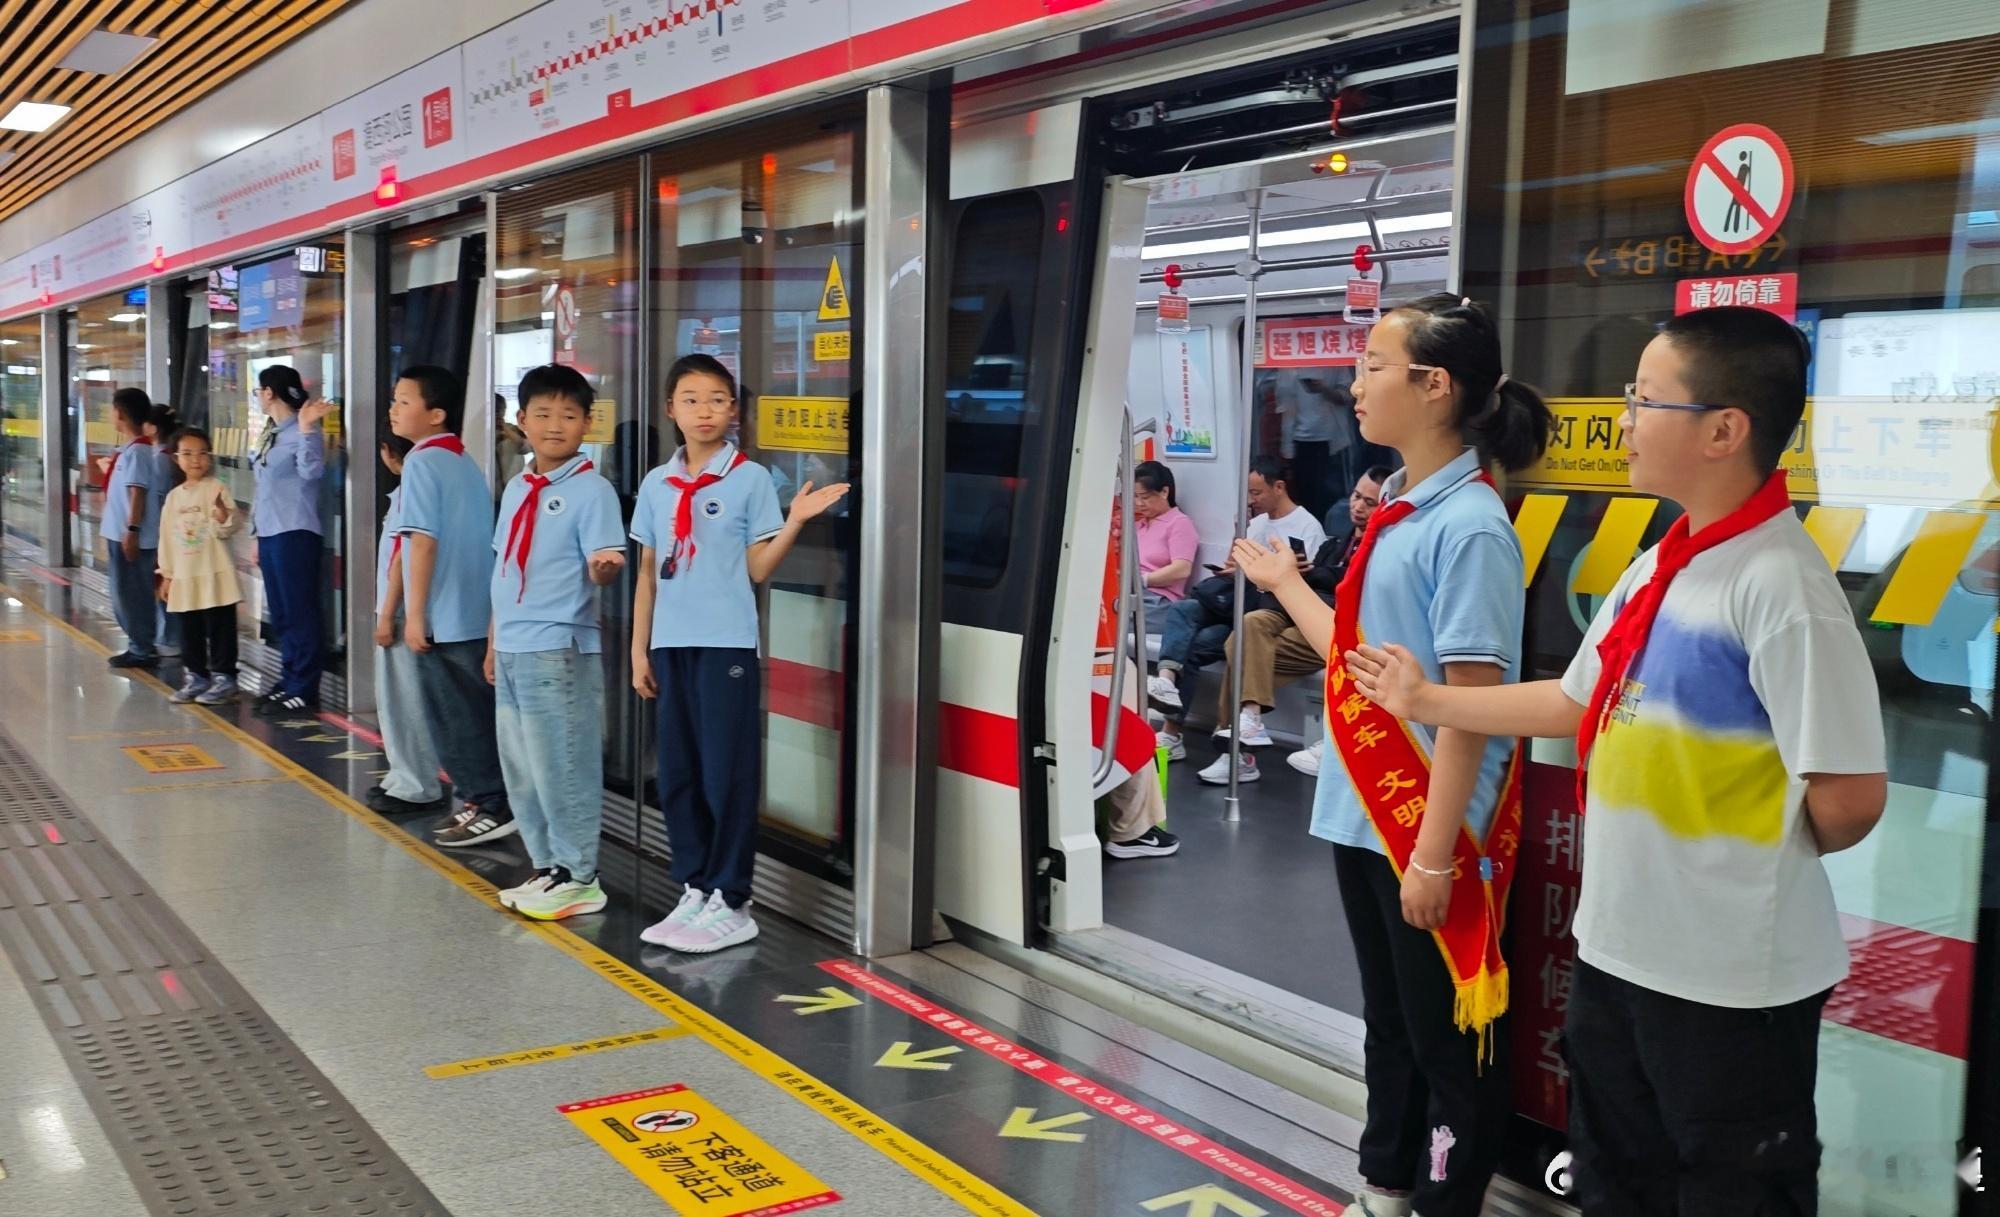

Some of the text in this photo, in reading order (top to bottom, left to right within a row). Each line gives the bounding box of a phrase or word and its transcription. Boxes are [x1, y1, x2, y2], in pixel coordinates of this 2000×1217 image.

[1690, 279, 1781, 307] 请勿倚靠
[1579, 458, 1595, 471] Get
[638, 1142, 735, 1203] 请勿站立
[688, 1132, 786, 1191] 下客通道
[1200, 1147, 1337, 1217] Please mind the
